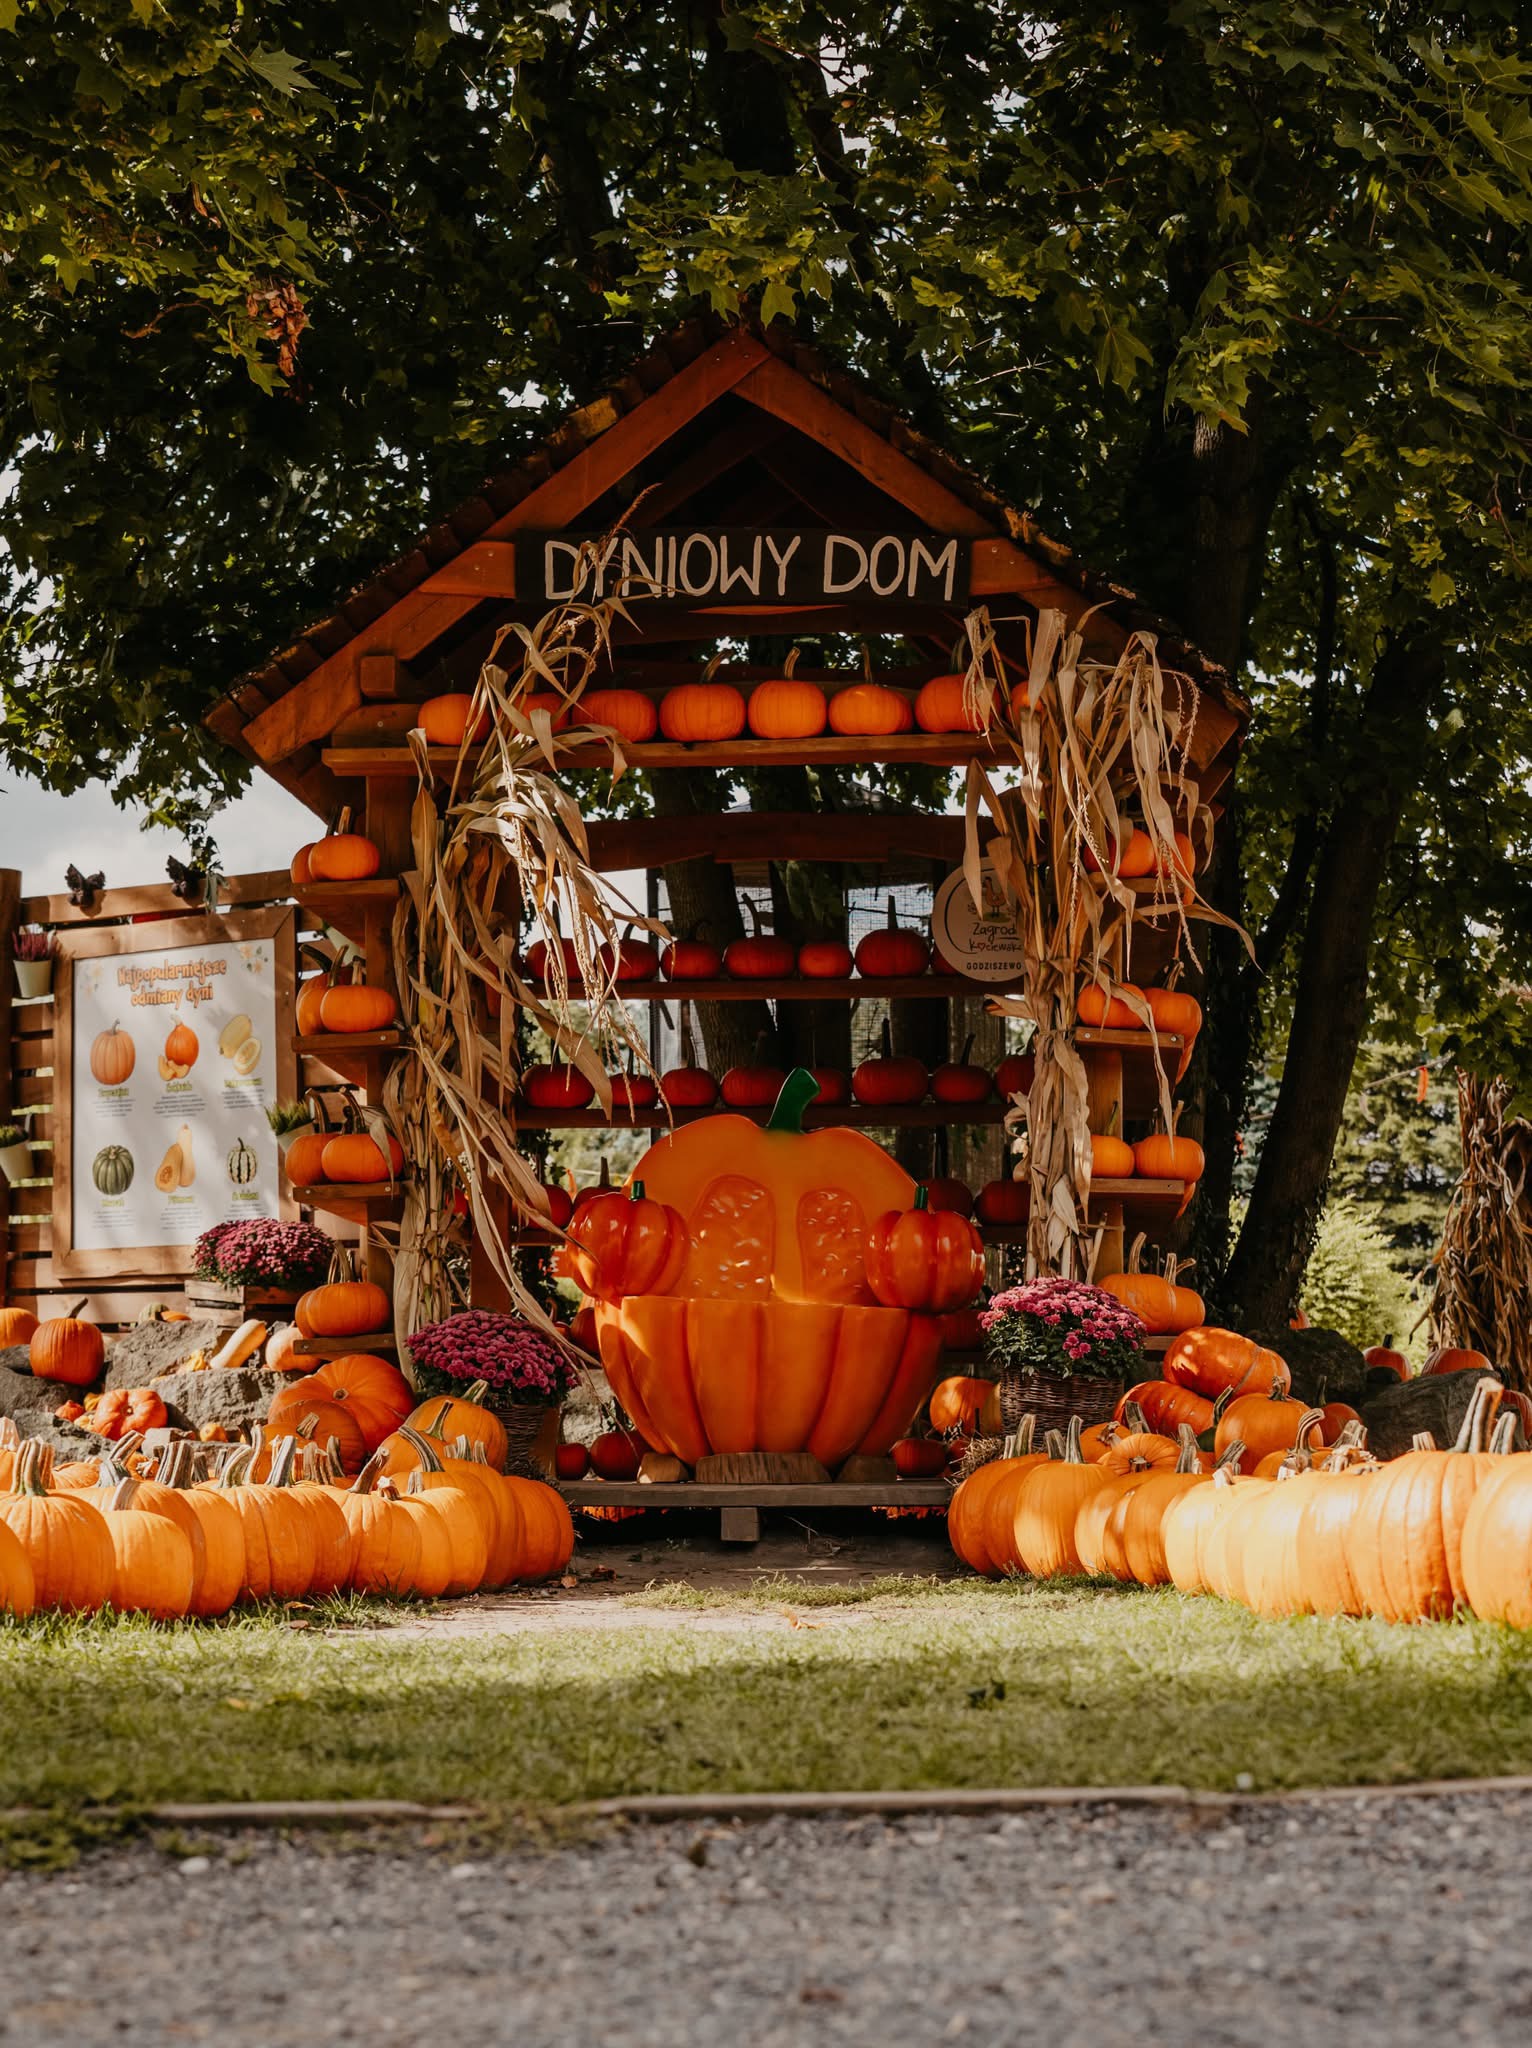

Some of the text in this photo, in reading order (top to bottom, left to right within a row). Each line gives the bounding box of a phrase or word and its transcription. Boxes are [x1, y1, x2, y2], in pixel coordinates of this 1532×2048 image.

[545, 533, 958, 601] DYNIOWY DOM
[972, 922, 1018, 944] Zagrod
[117, 959, 226, 991] Najpopularniejsze
[966, 961, 1022, 970] GODZISZEWO
[131, 980, 214, 1010] odmiany dyni
